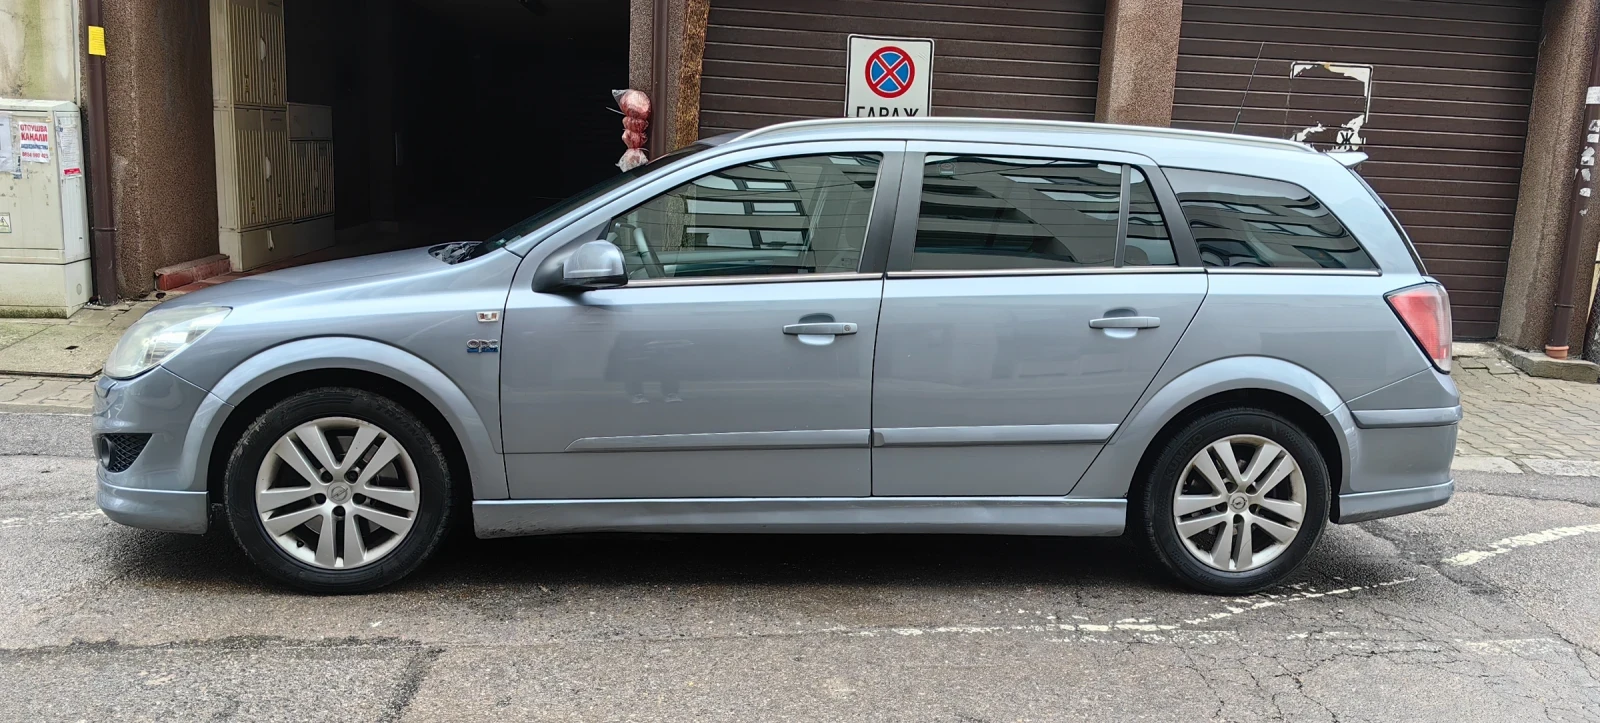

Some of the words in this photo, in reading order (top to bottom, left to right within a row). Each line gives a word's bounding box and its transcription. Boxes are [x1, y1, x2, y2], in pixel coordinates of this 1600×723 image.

[857, 106, 919, 117] ГАРАЖ
[21, 133, 48, 142] КАНАЛИ
[1165, 434, 1203, 480] KUMHO
